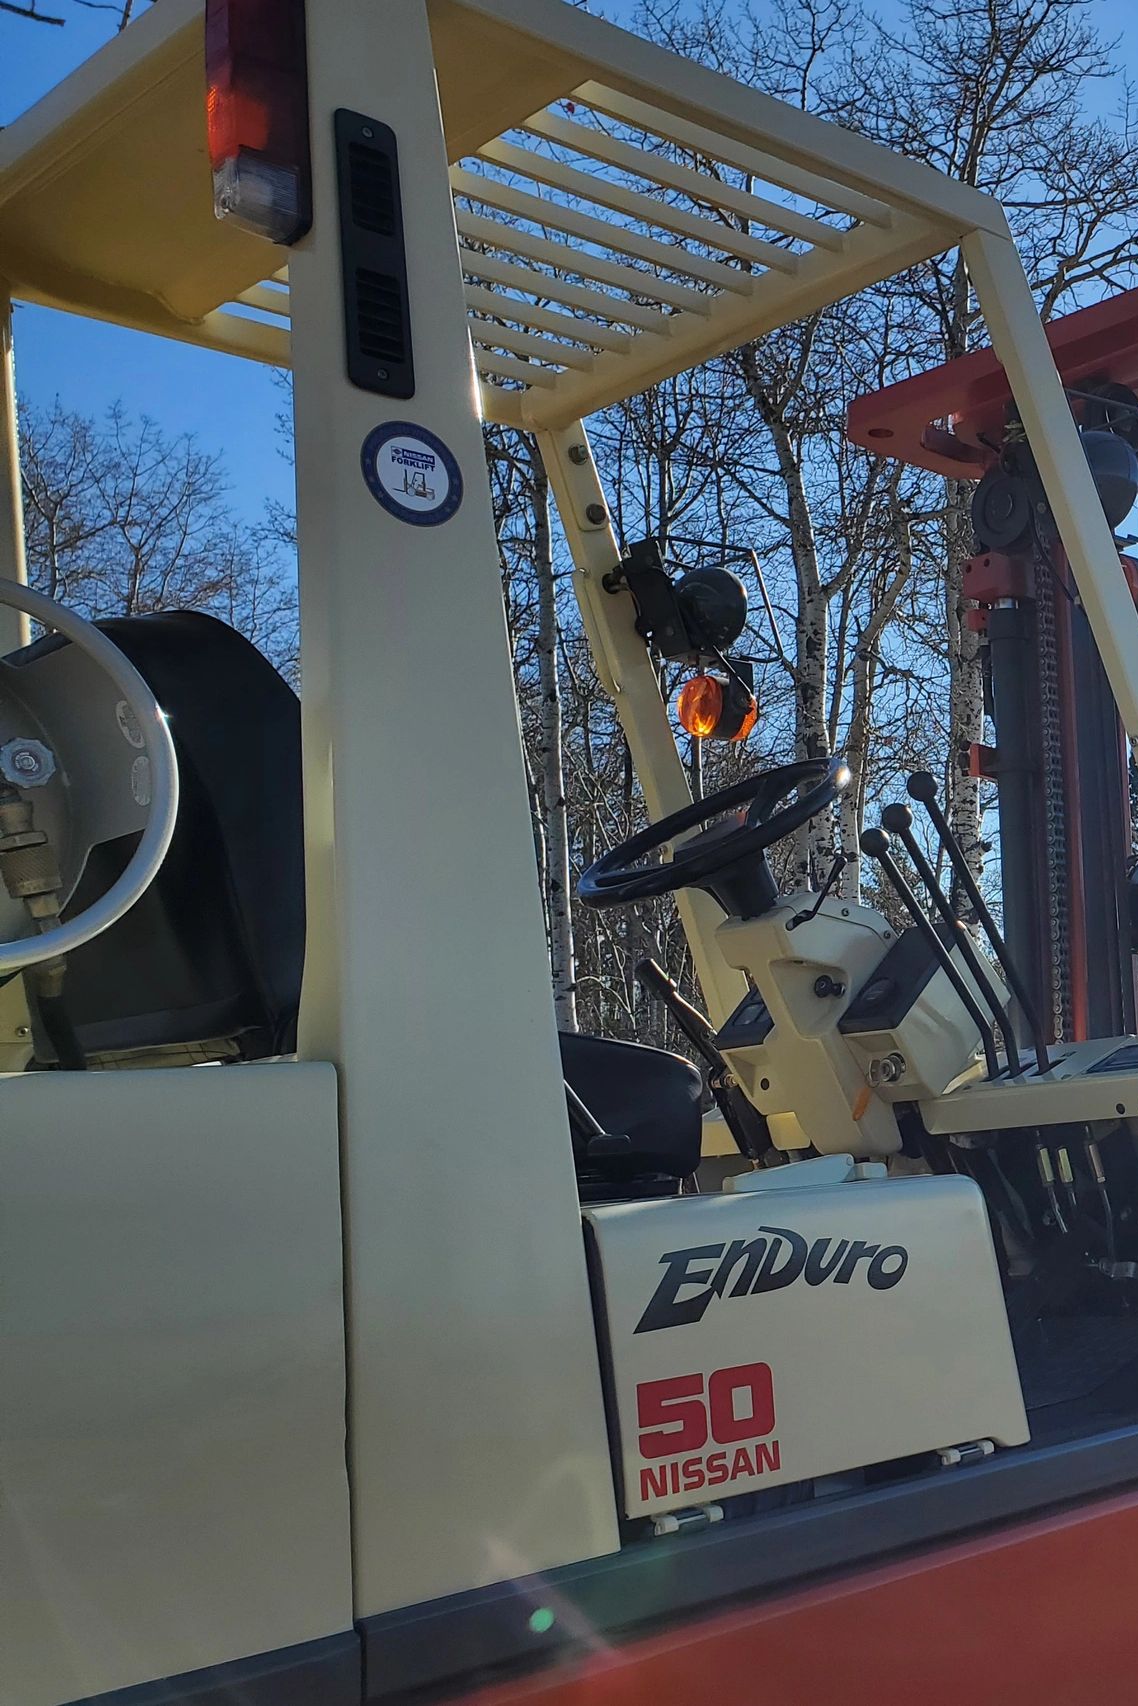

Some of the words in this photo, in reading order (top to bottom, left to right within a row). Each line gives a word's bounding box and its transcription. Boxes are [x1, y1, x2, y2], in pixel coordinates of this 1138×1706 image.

[391, 456, 436, 472] FORKLIFT
[403, 450, 434, 464] NISSAN
[636, 1362, 776, 1459] 50
[640, 1440, 781, 1501] NISSAN
